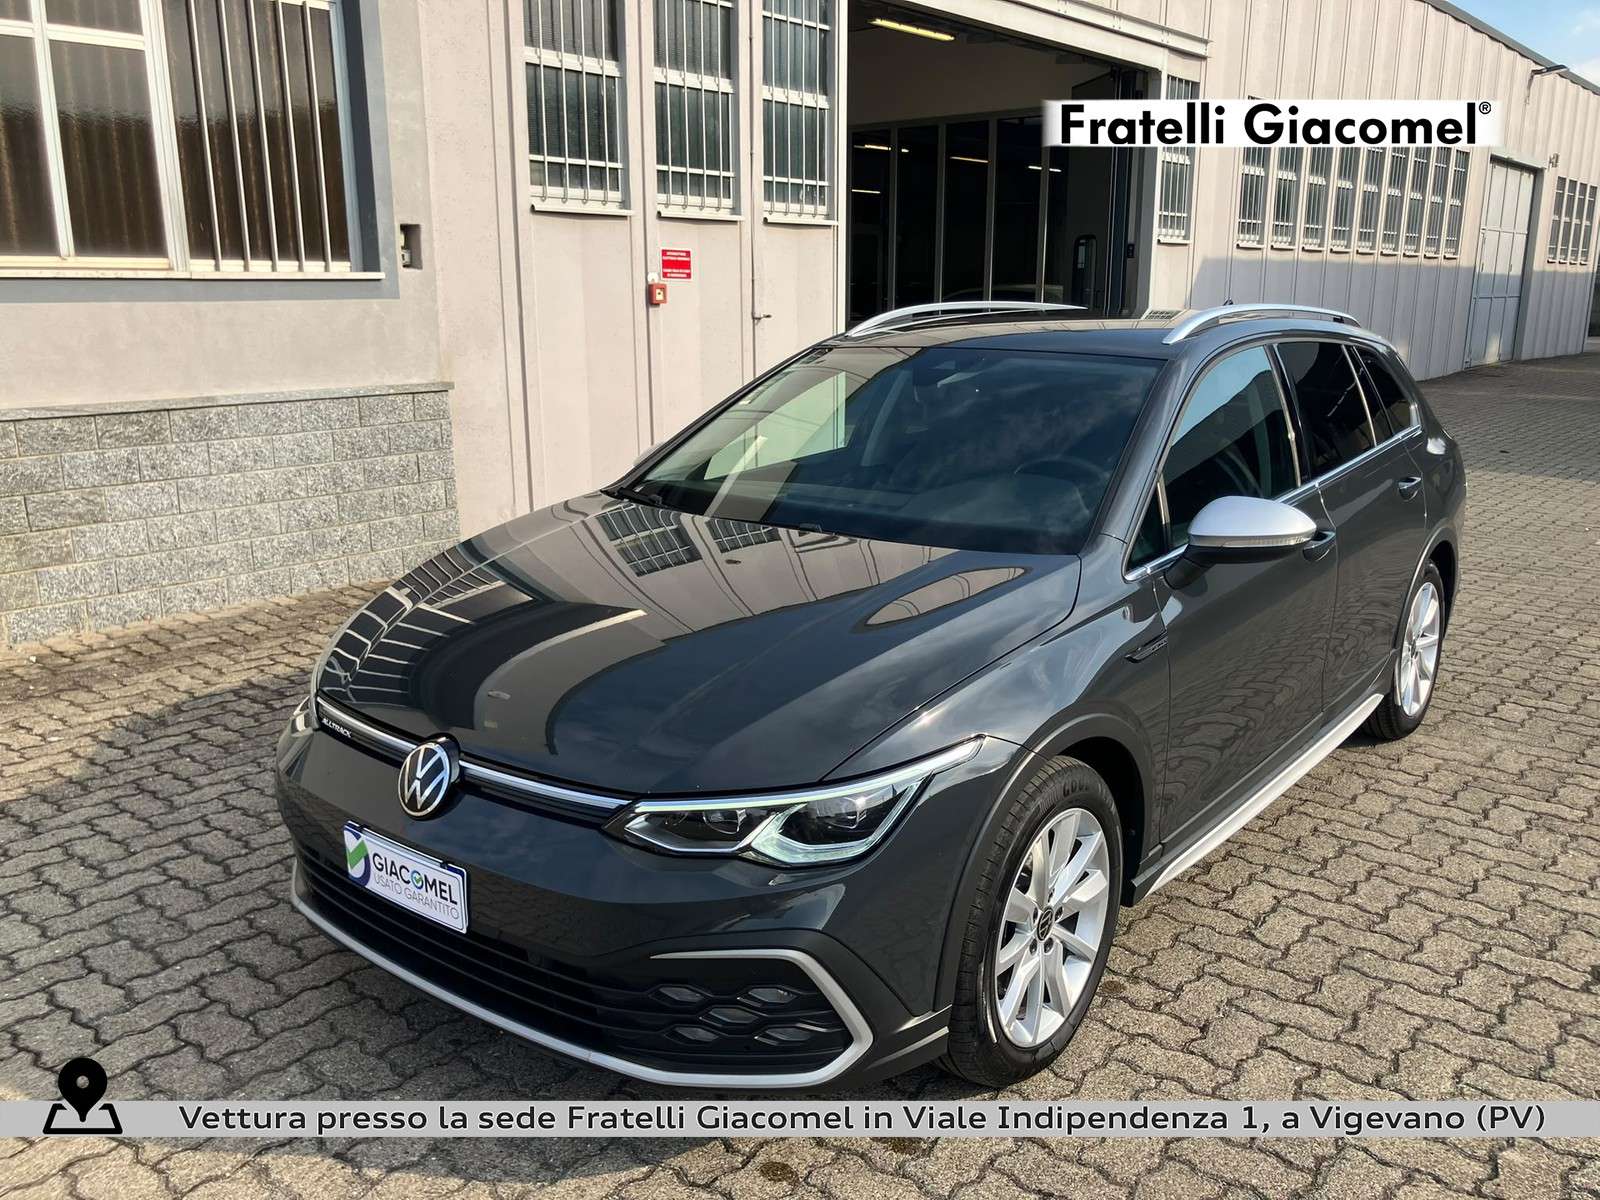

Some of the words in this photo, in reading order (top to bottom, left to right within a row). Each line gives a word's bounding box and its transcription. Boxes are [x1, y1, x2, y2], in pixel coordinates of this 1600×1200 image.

[322, 718, 352, 738] ALLTRACK
[372, 852, 459, 905] GIACOMEL
[373, 873, 402, 895] USATO
[403, 887, 460, 920] GARANTITO
